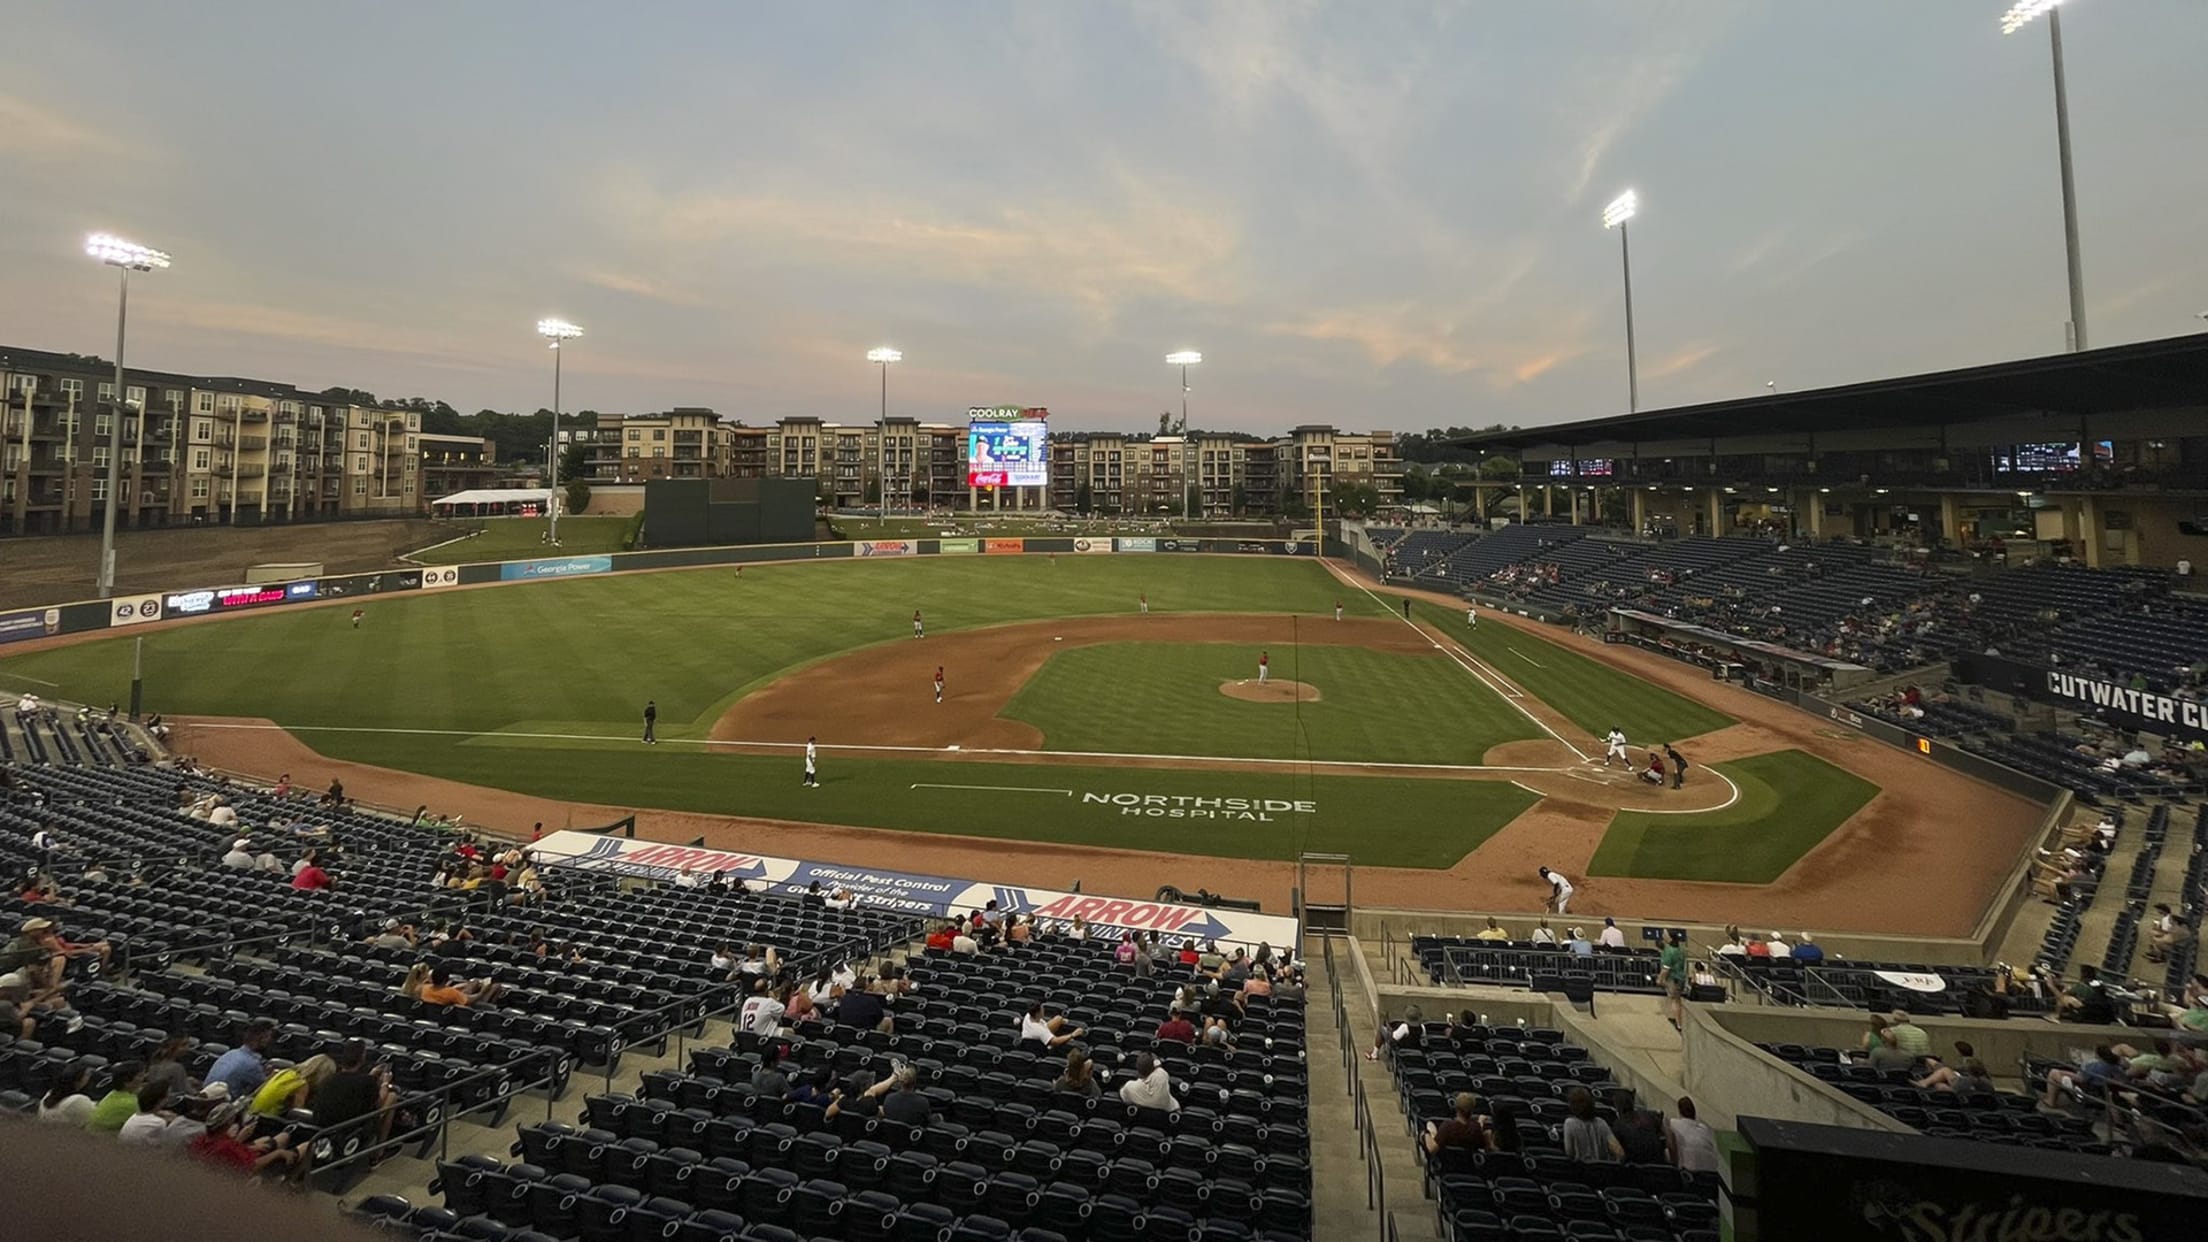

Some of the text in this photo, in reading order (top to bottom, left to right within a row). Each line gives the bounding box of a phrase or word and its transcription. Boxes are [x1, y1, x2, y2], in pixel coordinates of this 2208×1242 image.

[969, 408, 1018, 418] COOLRAY
[537, 563, 591, 574] Georgia Power
[2047, 671, 2175, 723] CUTWATER
[1082, 792, 1317, 813] NORTHSIDE
[1121, 807, 1274, 822] HOSPITAL
[616, 845, 759, 872] ARROW
[809, 867, 950, 893] Official Pest Control
[827, 880, 909, 897] Provider of the
[864, 894, 933, 912] Stripers
[1034, 896, 1203, 930] ARROW
[743, 1012, 756, 1031] 12
